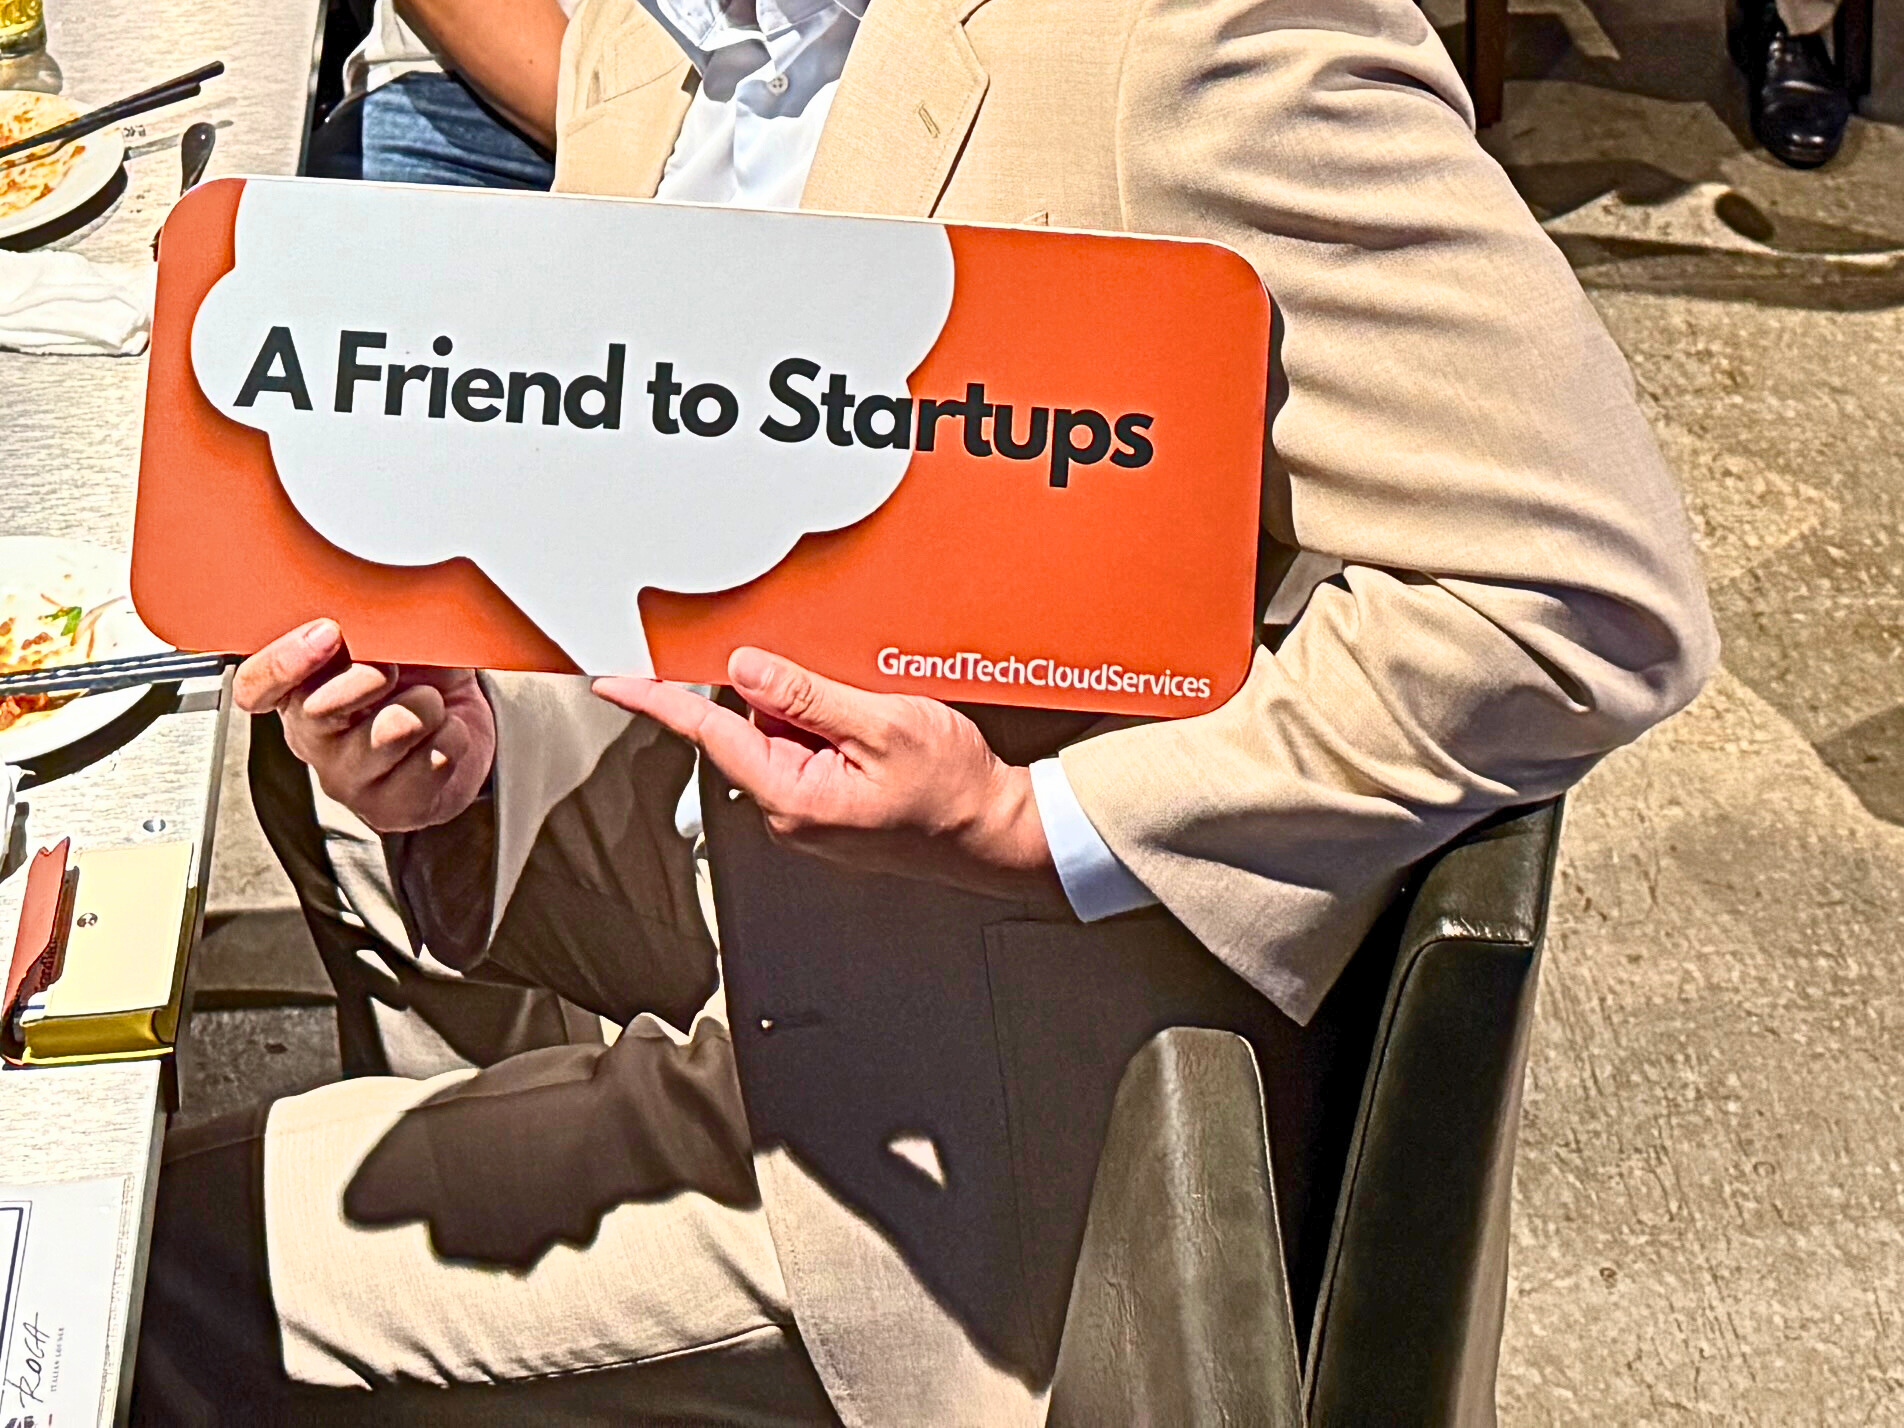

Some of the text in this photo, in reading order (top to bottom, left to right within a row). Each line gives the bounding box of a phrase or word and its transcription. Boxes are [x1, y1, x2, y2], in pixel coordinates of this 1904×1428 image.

[233, 324, 1156, 489] A Friend to Startups
[876, 646, 1212, 700] GrandTechCloudServices
